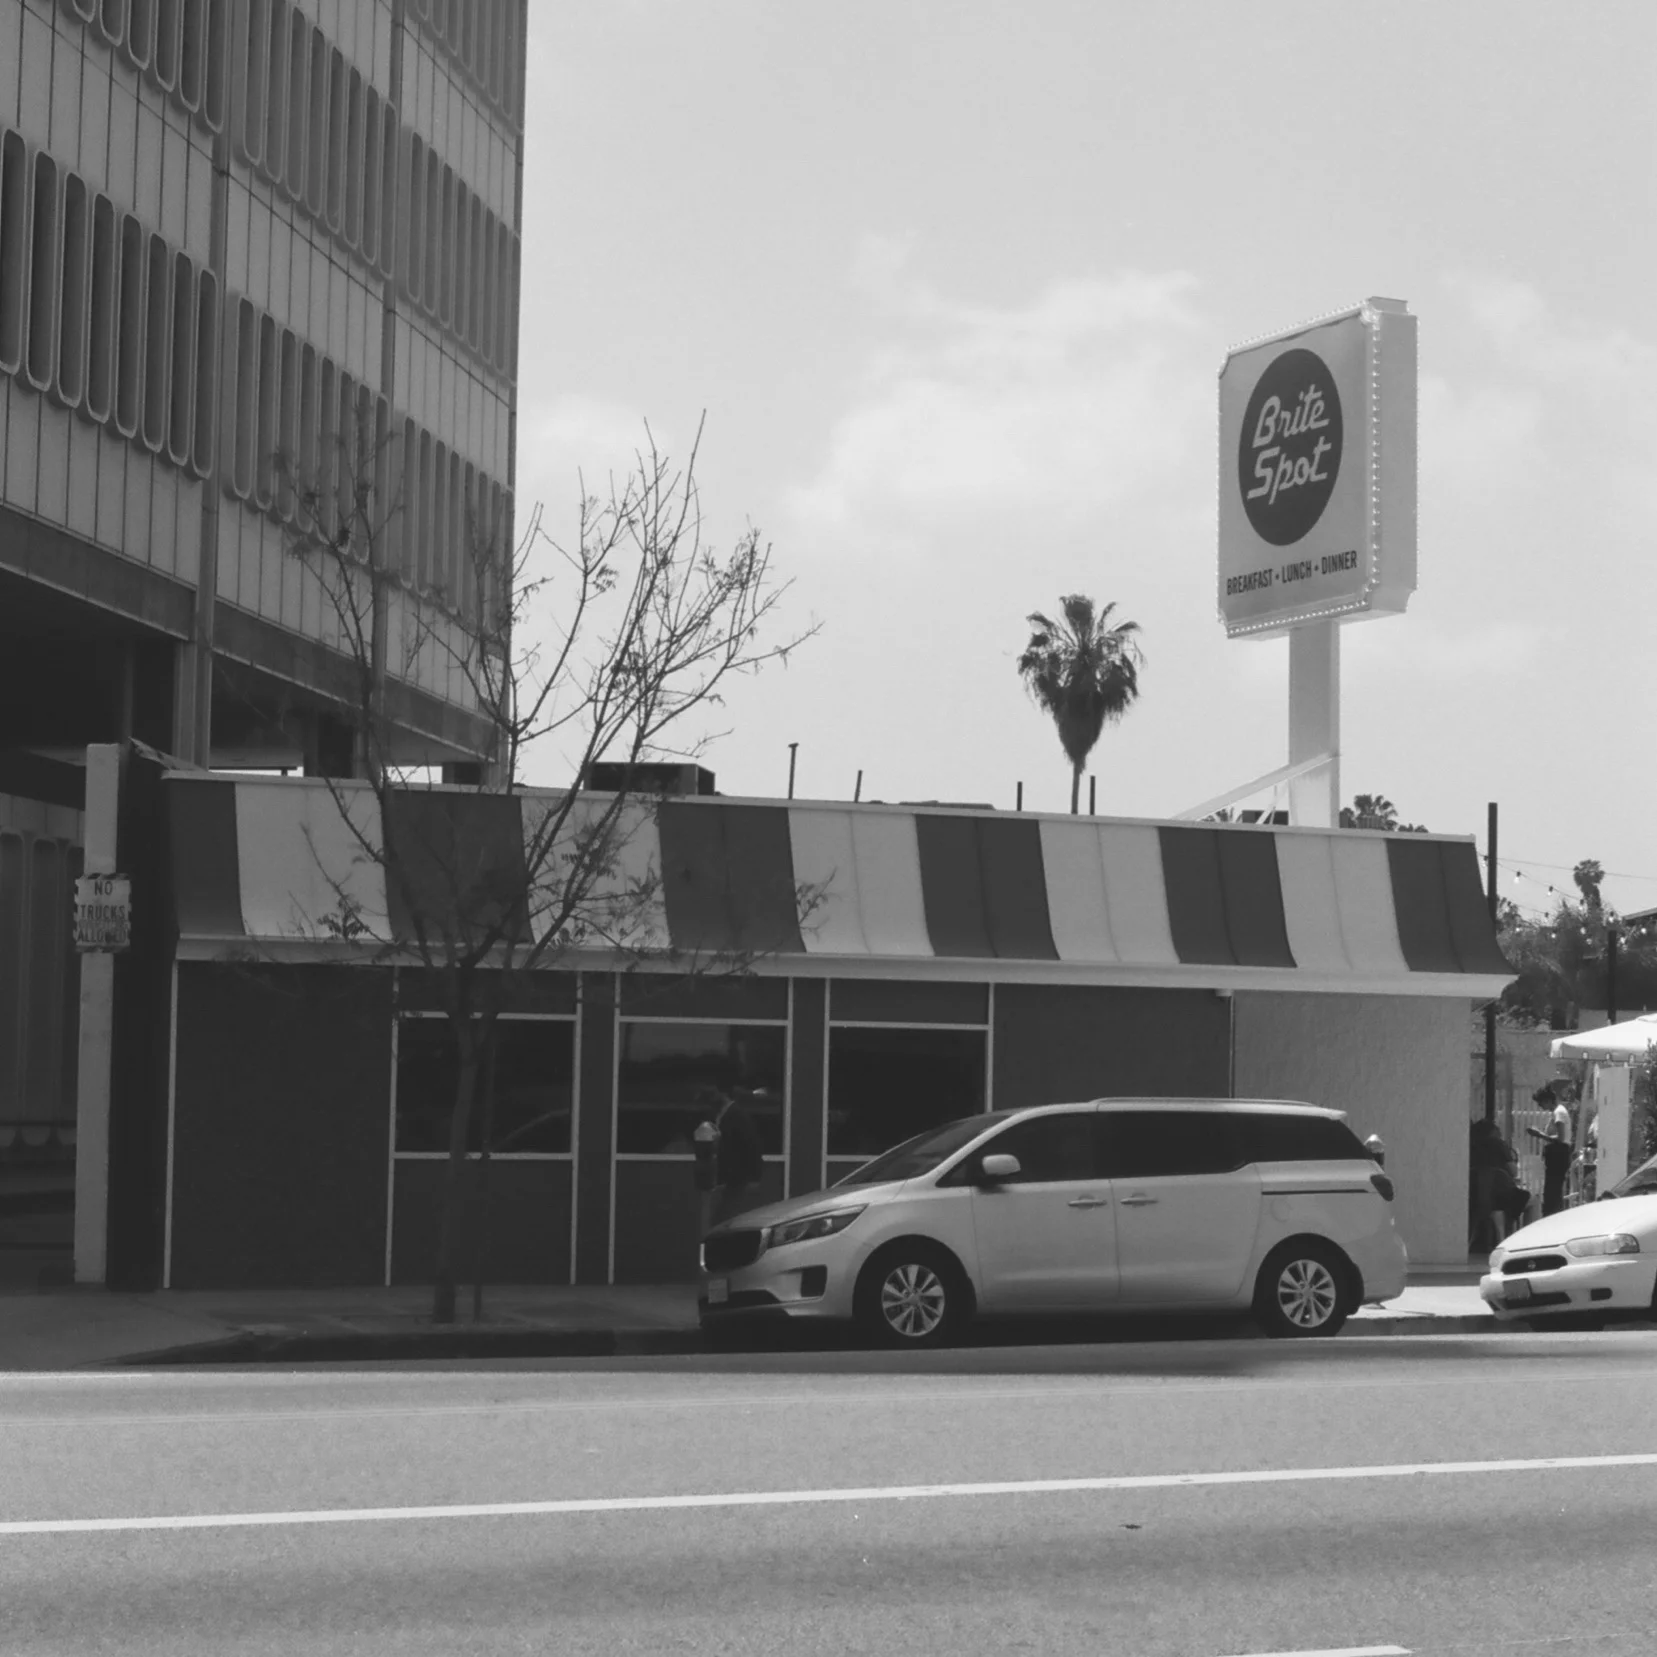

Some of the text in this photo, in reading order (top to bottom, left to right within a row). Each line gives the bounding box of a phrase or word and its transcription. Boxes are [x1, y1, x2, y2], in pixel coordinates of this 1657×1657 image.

[1252, 384, 1329, 448] Brite
[1247, 436, 1332, 505] Spot
[1227, 550, 1357, 595] BREAKFAST LUNCH DINNER
[94, 881, 113, 896] NO
[80, 904, 125, 920] TRUCKS
[77, 928, 127, 943] ALLOD
